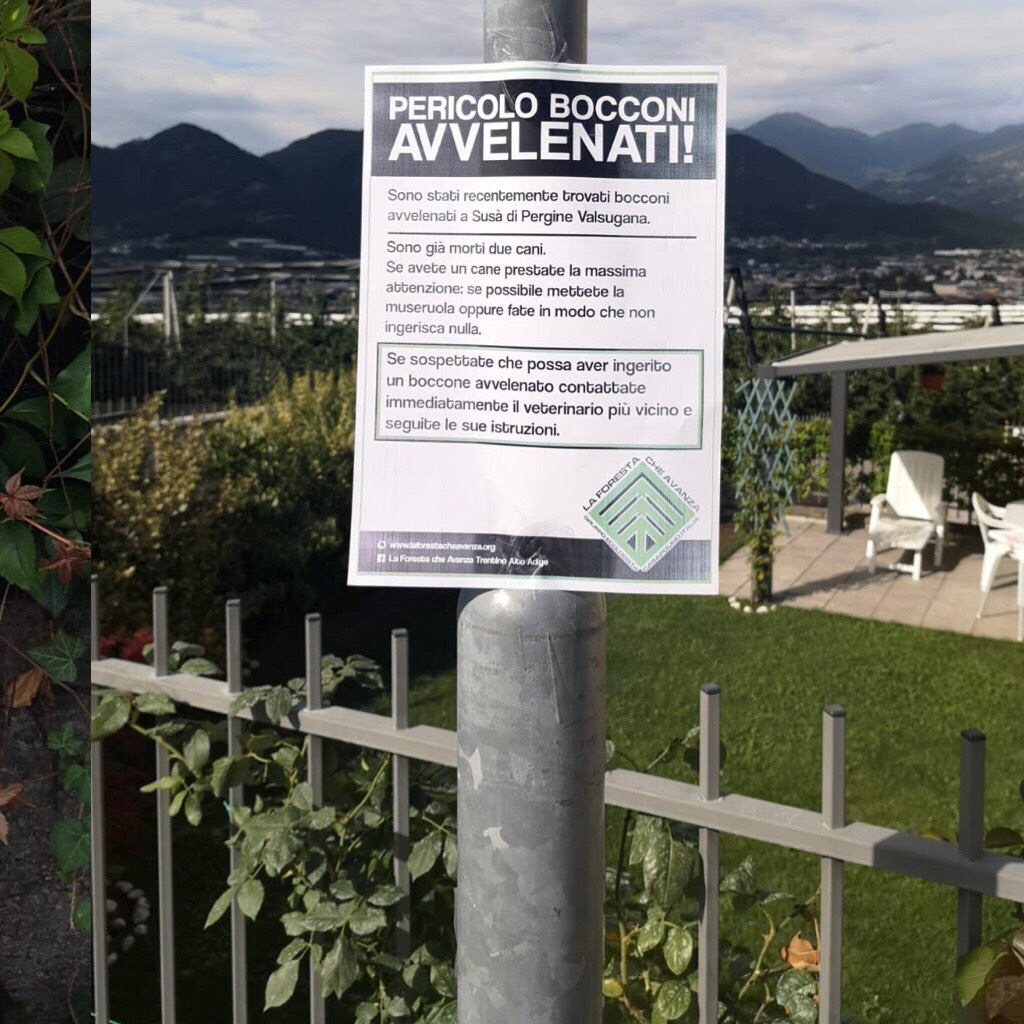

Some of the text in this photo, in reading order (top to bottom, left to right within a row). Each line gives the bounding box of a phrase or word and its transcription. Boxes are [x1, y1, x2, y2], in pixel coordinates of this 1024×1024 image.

[389, 92, 695, 122] PERICOLO BOCCONI
[388, 121, 694, 164] AVVELENATI!
[387, 188, 670, 204] Sono stati recentemente trovati bocconi
[387, 209, 650, 227] avvelenati a Susà di Pergine Valsugana.
[386, 240, 546, 257] Sono già morti due cani.
[386, 260, 646, 279] Se avete un cane prestate la massima
[385, 281, 624, 299] attenzione: se possibile mettete la
[385, 301, 655, 318] museruola oppure fate in modo che non
[384, 320, 481, 336] ingerisca nulla.
[387, 351, 671, 376] Se sospettate che possa aver ingerito
[386, 373, 646, 394] un boccone avvelenato contattate
[385, 394, 692, 420] immediatamente il veterinario più vicino e
[385, 417, 560, 436] seguite le sue istruzioni.
[582, 456, 641, 511] LA FORESTA
[645, 456, 700, 512] CHE AVANZA
